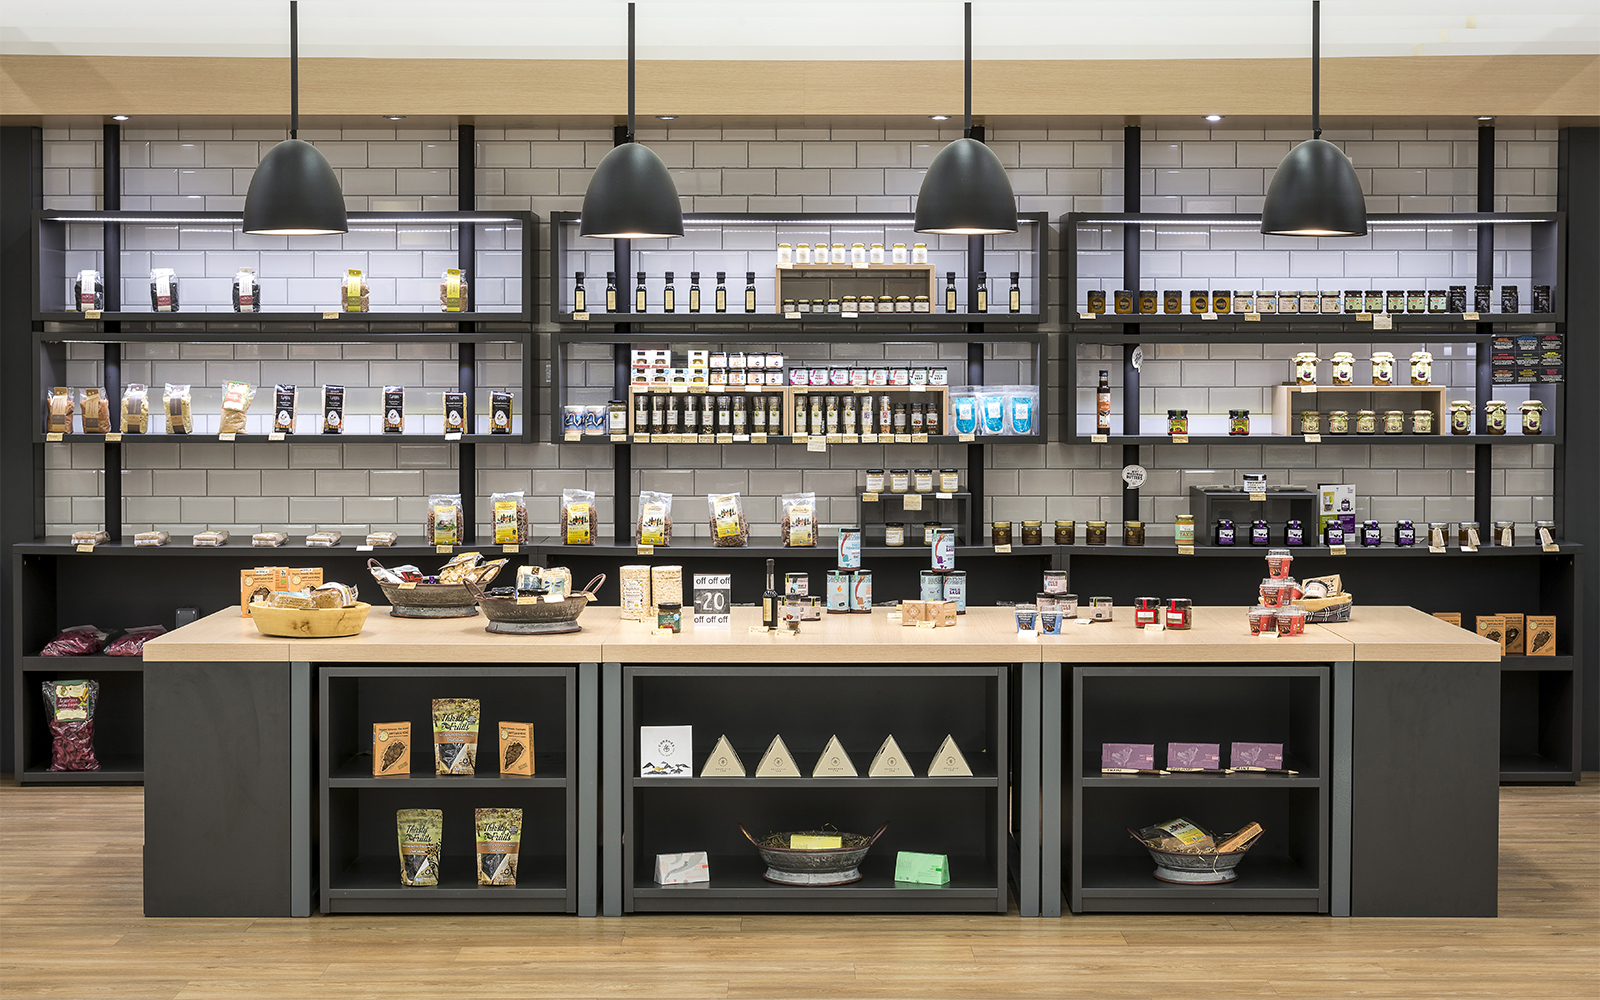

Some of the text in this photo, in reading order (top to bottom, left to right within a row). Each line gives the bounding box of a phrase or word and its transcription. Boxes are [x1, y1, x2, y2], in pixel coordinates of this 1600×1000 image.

[696, 577, 730, 585] off off off
